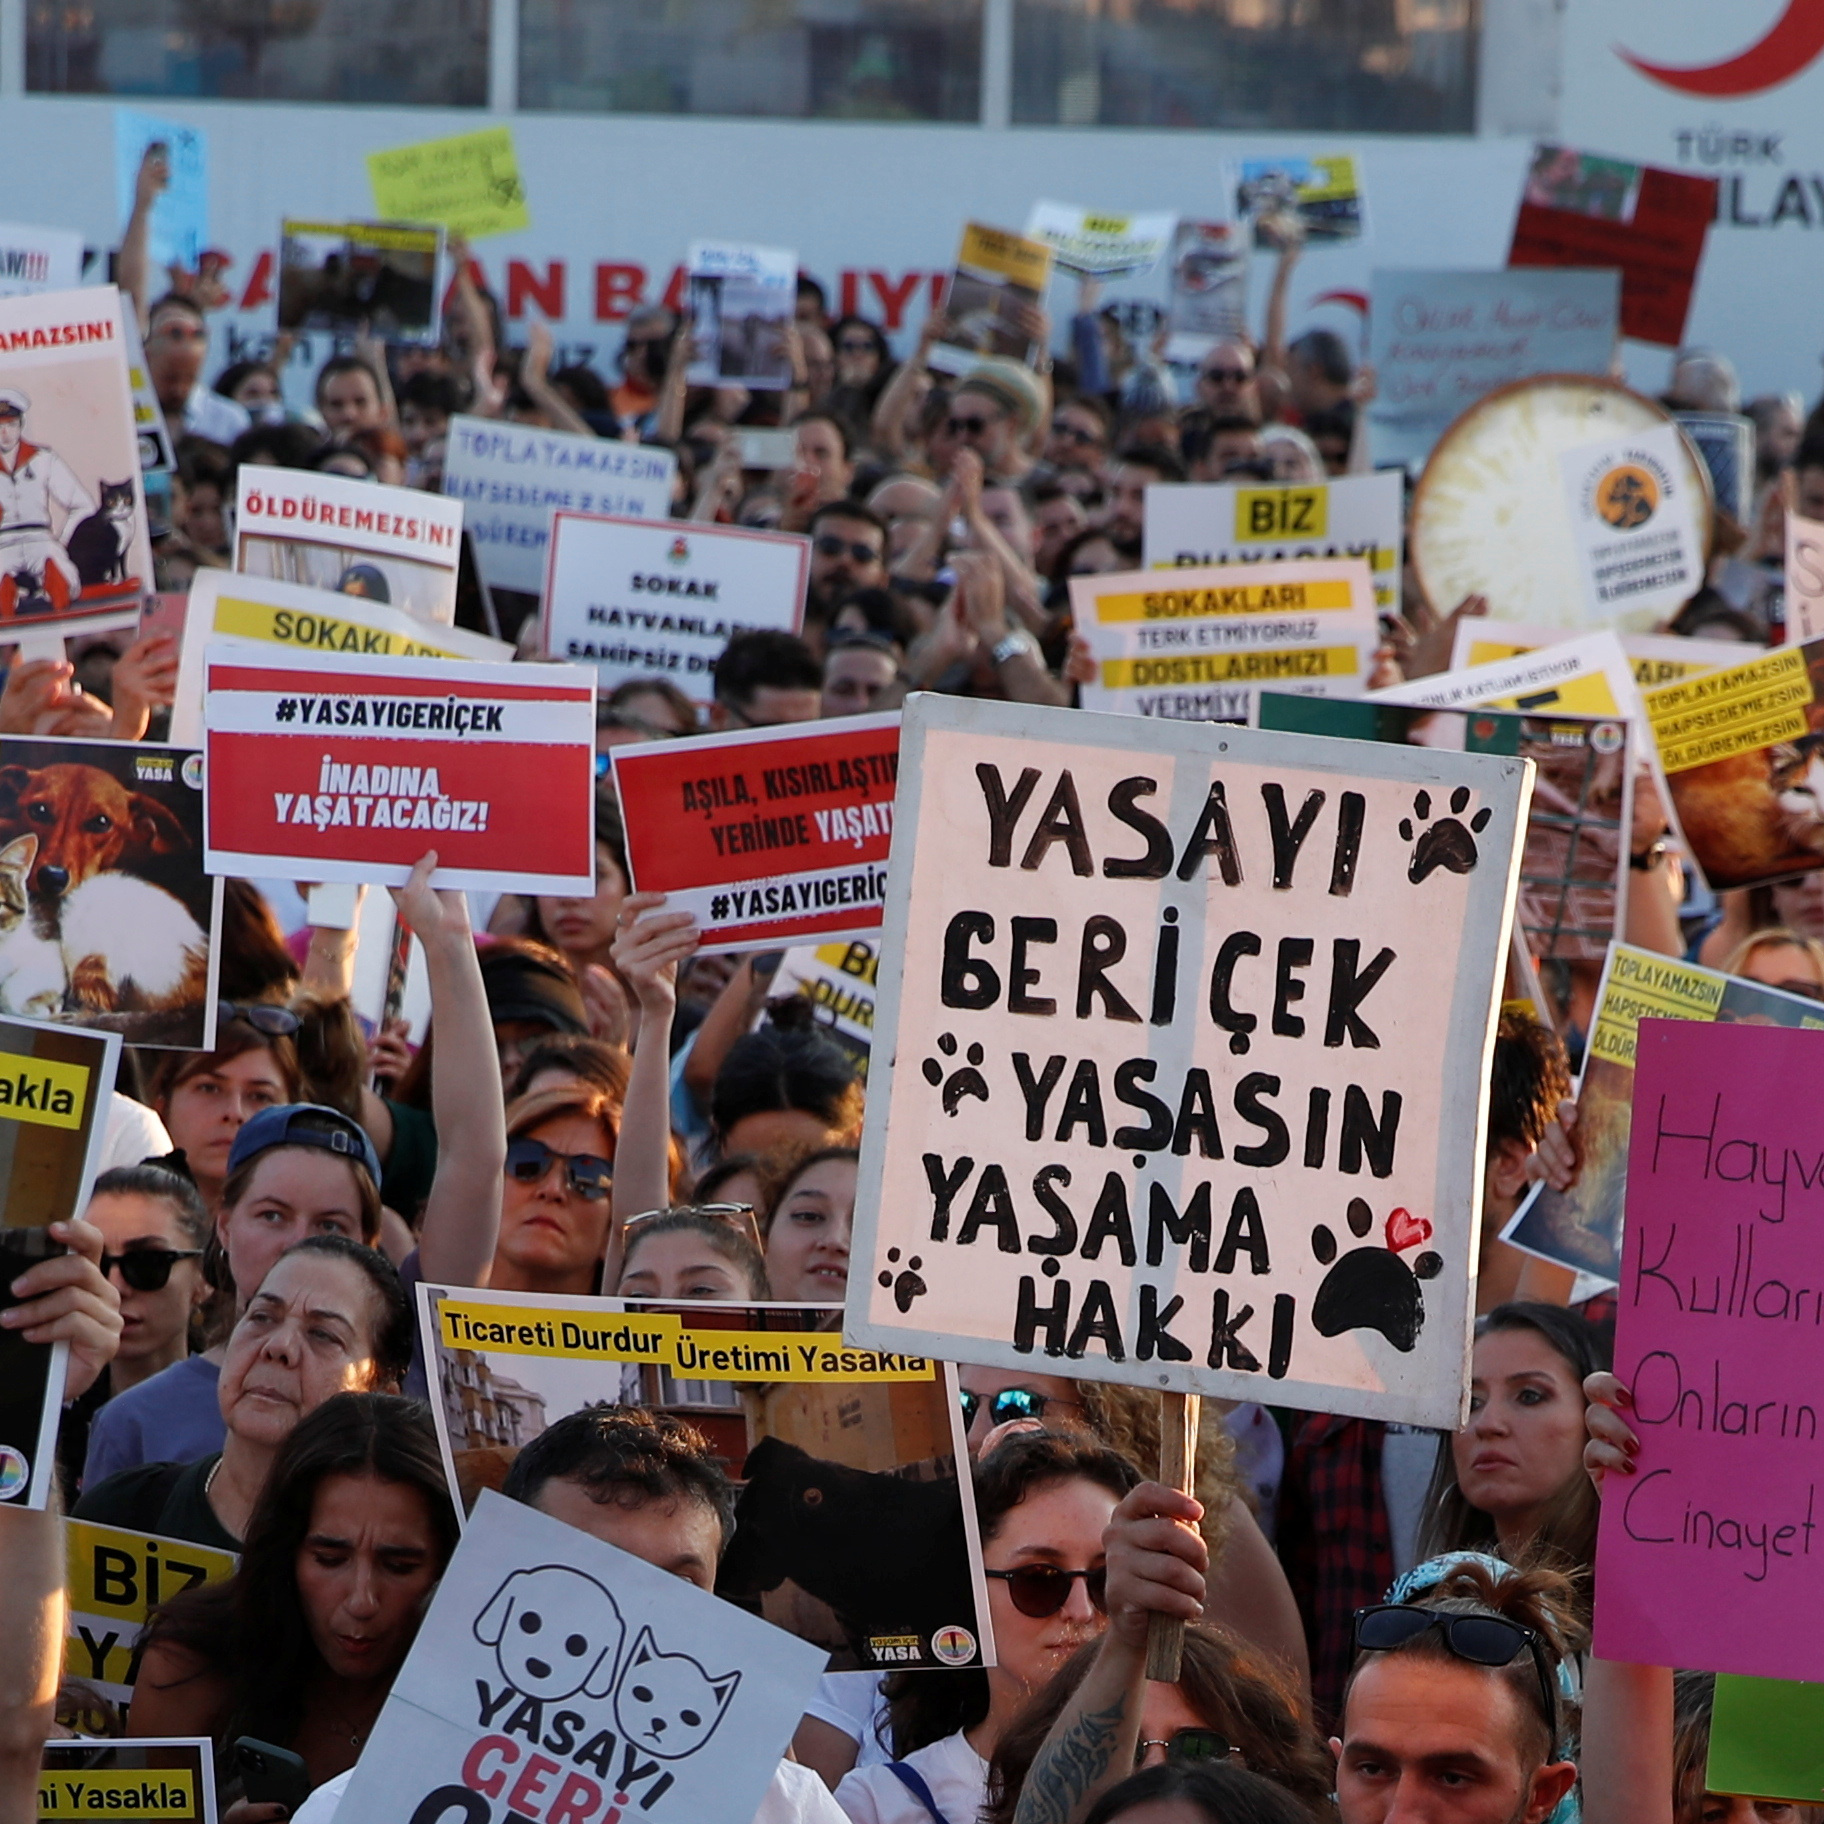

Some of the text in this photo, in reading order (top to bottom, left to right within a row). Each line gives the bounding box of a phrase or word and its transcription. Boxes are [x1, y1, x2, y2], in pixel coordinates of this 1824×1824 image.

[1674, 128, 1786, 161] TÜRK
[244, 491, 455, 548] ÖLDÜREMEZSİN!
[1250, 485, 1315, 534] BİZ
[631, 573, 720, 600] SOKAK
[1143, 581, 1307, 618] SOKAKLARI
[1137, 619, 1318, 649] TERK ETMİYORUZ
[1132, 651, 1328, 688] DOSTLARIMIZI
[276, 695, 504, 737] #YASAYIGERİÇEK
[137, 767, 173, 782] YASA
[319, 753, 439, 796] İNADINA
[274, 791, 489, 834] YAŞATACAĞIZ!
[682, 774, 759, 822] AŞILA,
[711, 814, 810, 857] YERİNDE
[976, 762, 1366, 898] YASAYI
[940, 907, 1181, 1026] GERİ
[1209, 930, 1398, 1056] ÇEK
[1011, 1052, 1404, 1180] YAŞASIN
[921, 1153, 1272, 1276] YAŞAMA
[444, 1312, 556, 1349] Ticareti
[561, 1321, 664, 1355] Durdur
[676, 1334, 791, 1373] Üretimi
[1013, 1275, 1297, 1380] HAKKI
[1632, 1350, 1817, 1442] Onların
[1623, 1468, 1817, 1581] Cinayet
[872, 1647, 921, 1662] YASA
[474, 1678, 675, 1812] YASAYI
[64, 1782, 188, 1811] Yasakla
